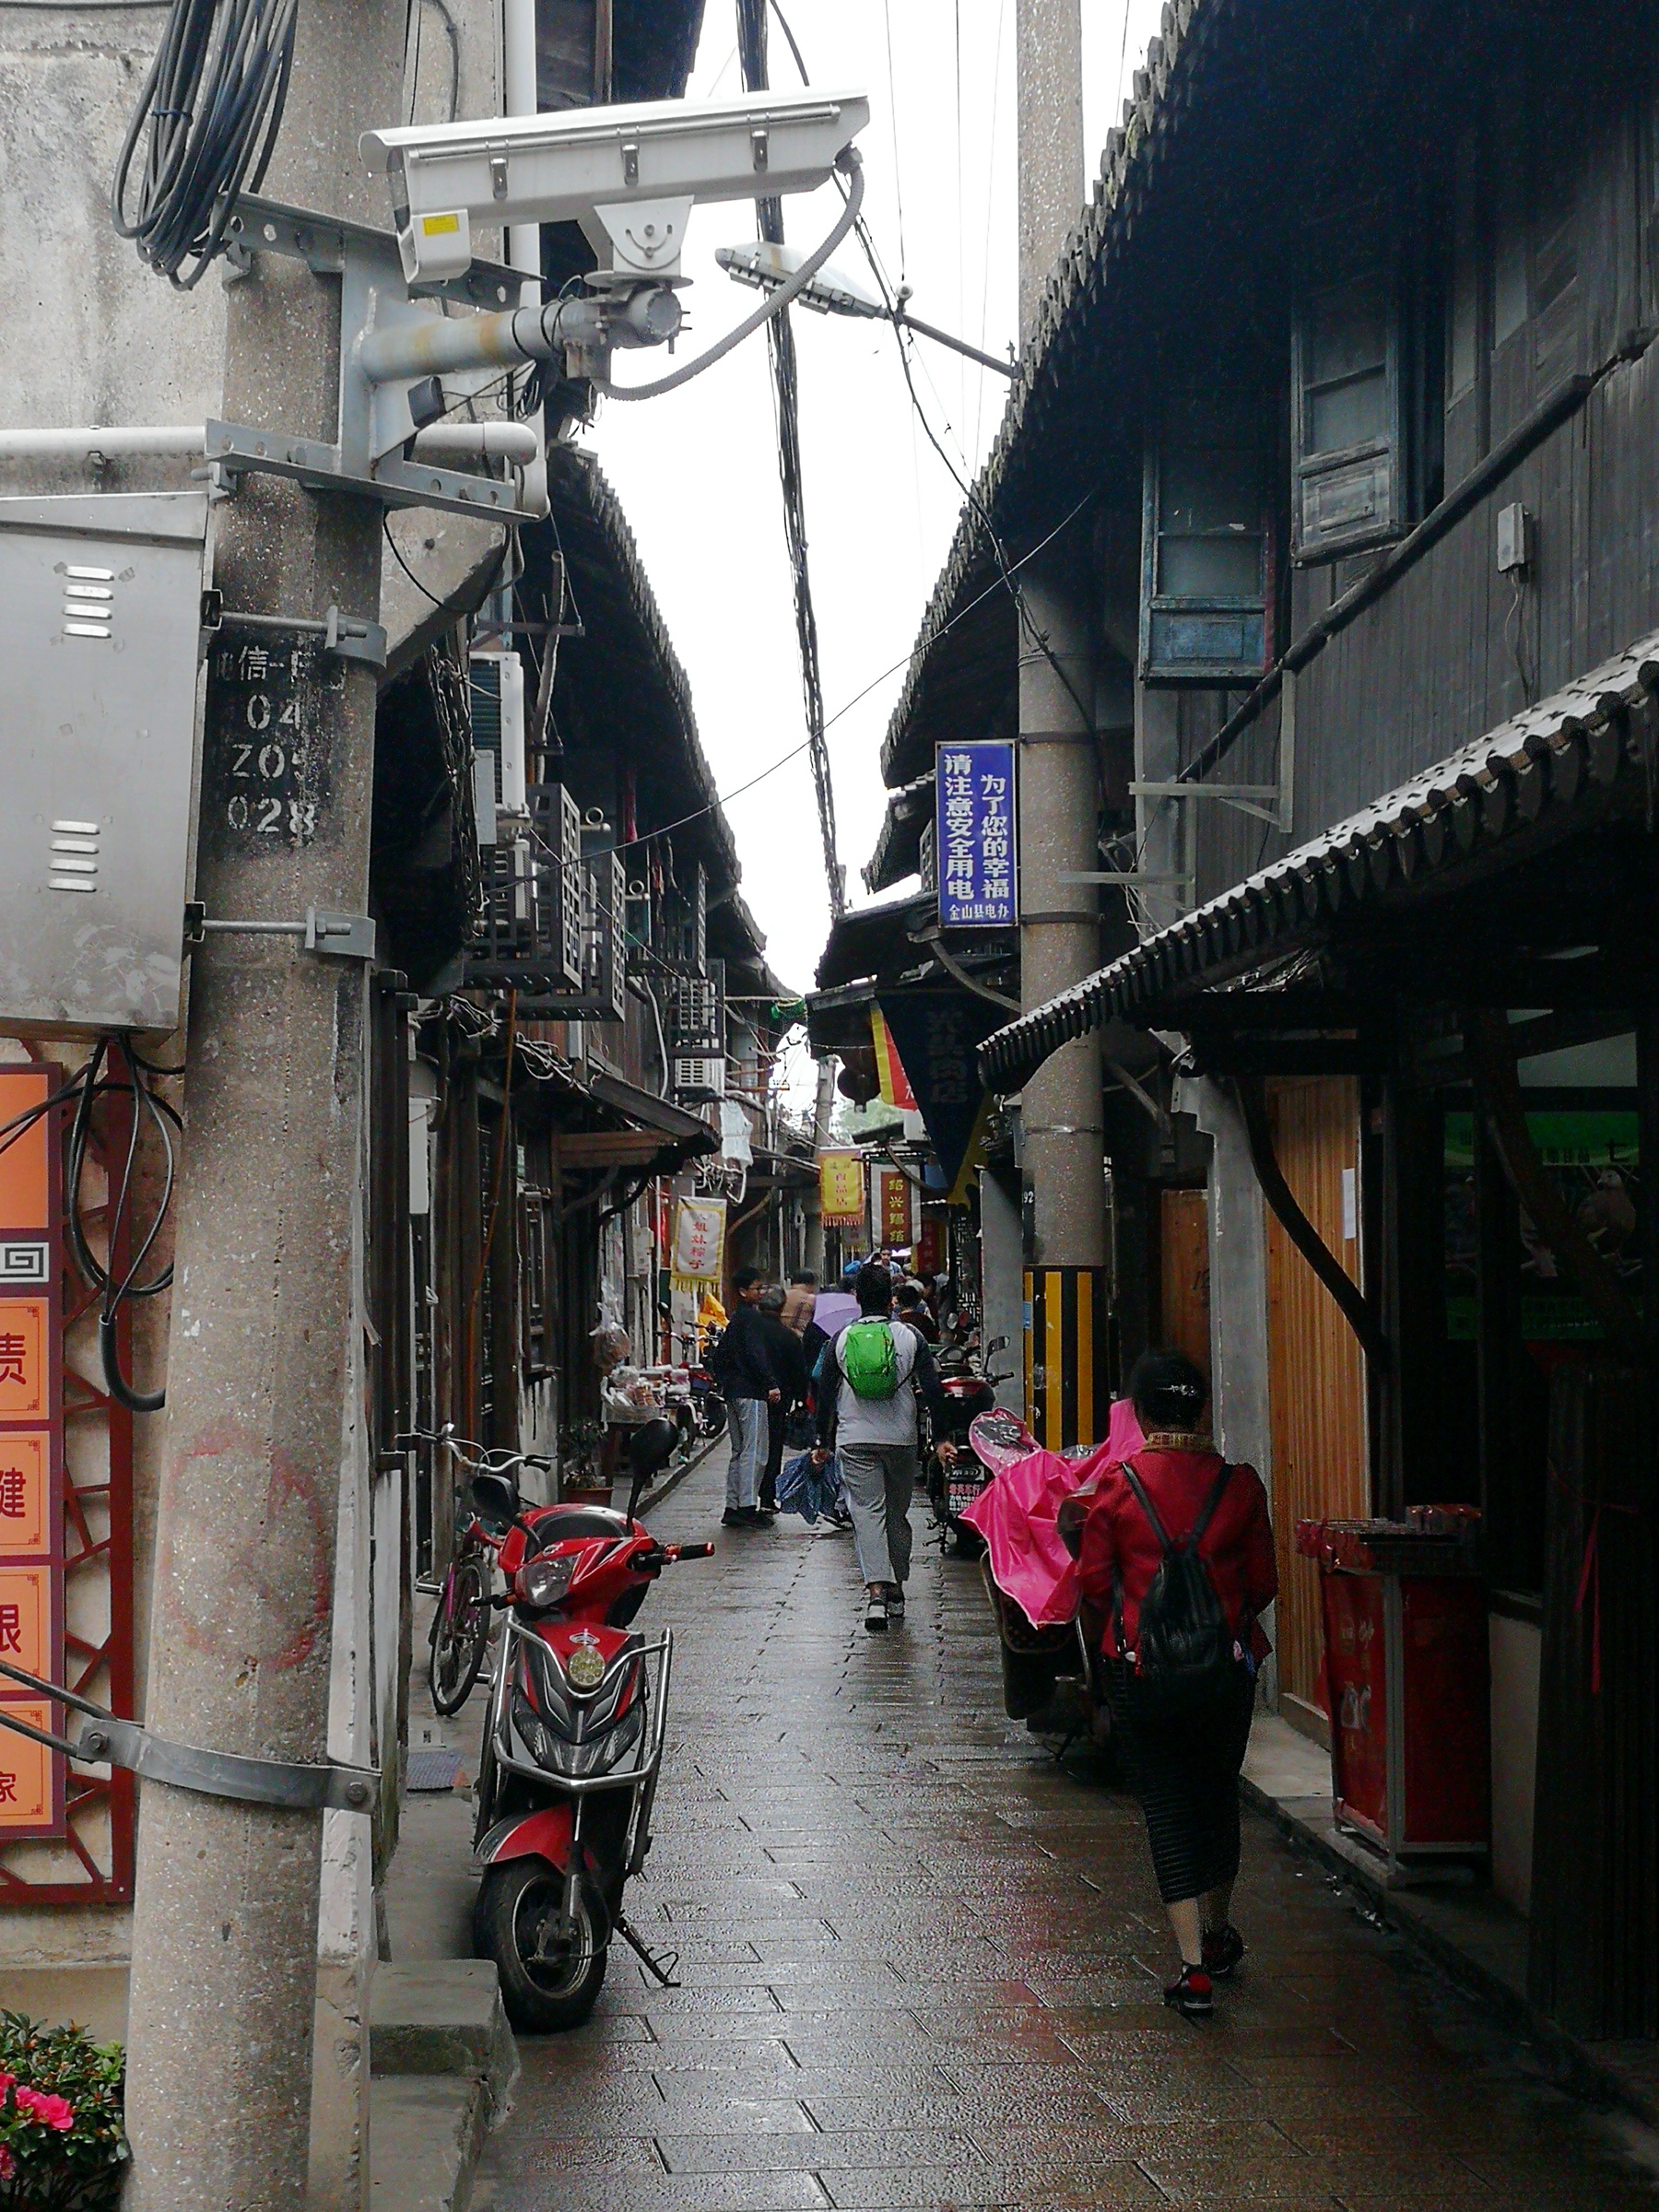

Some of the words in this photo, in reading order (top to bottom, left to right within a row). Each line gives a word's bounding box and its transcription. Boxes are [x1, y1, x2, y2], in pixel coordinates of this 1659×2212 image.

[246, 694, 302, 730] 04
[228, 795, 315, 835] 028
[944, 753, 976, 900] 请注意安全用电
[981, 773, 1010, 900] 为了您的幸福
[688, 1221, 708, 1270] 姐妹粽子
